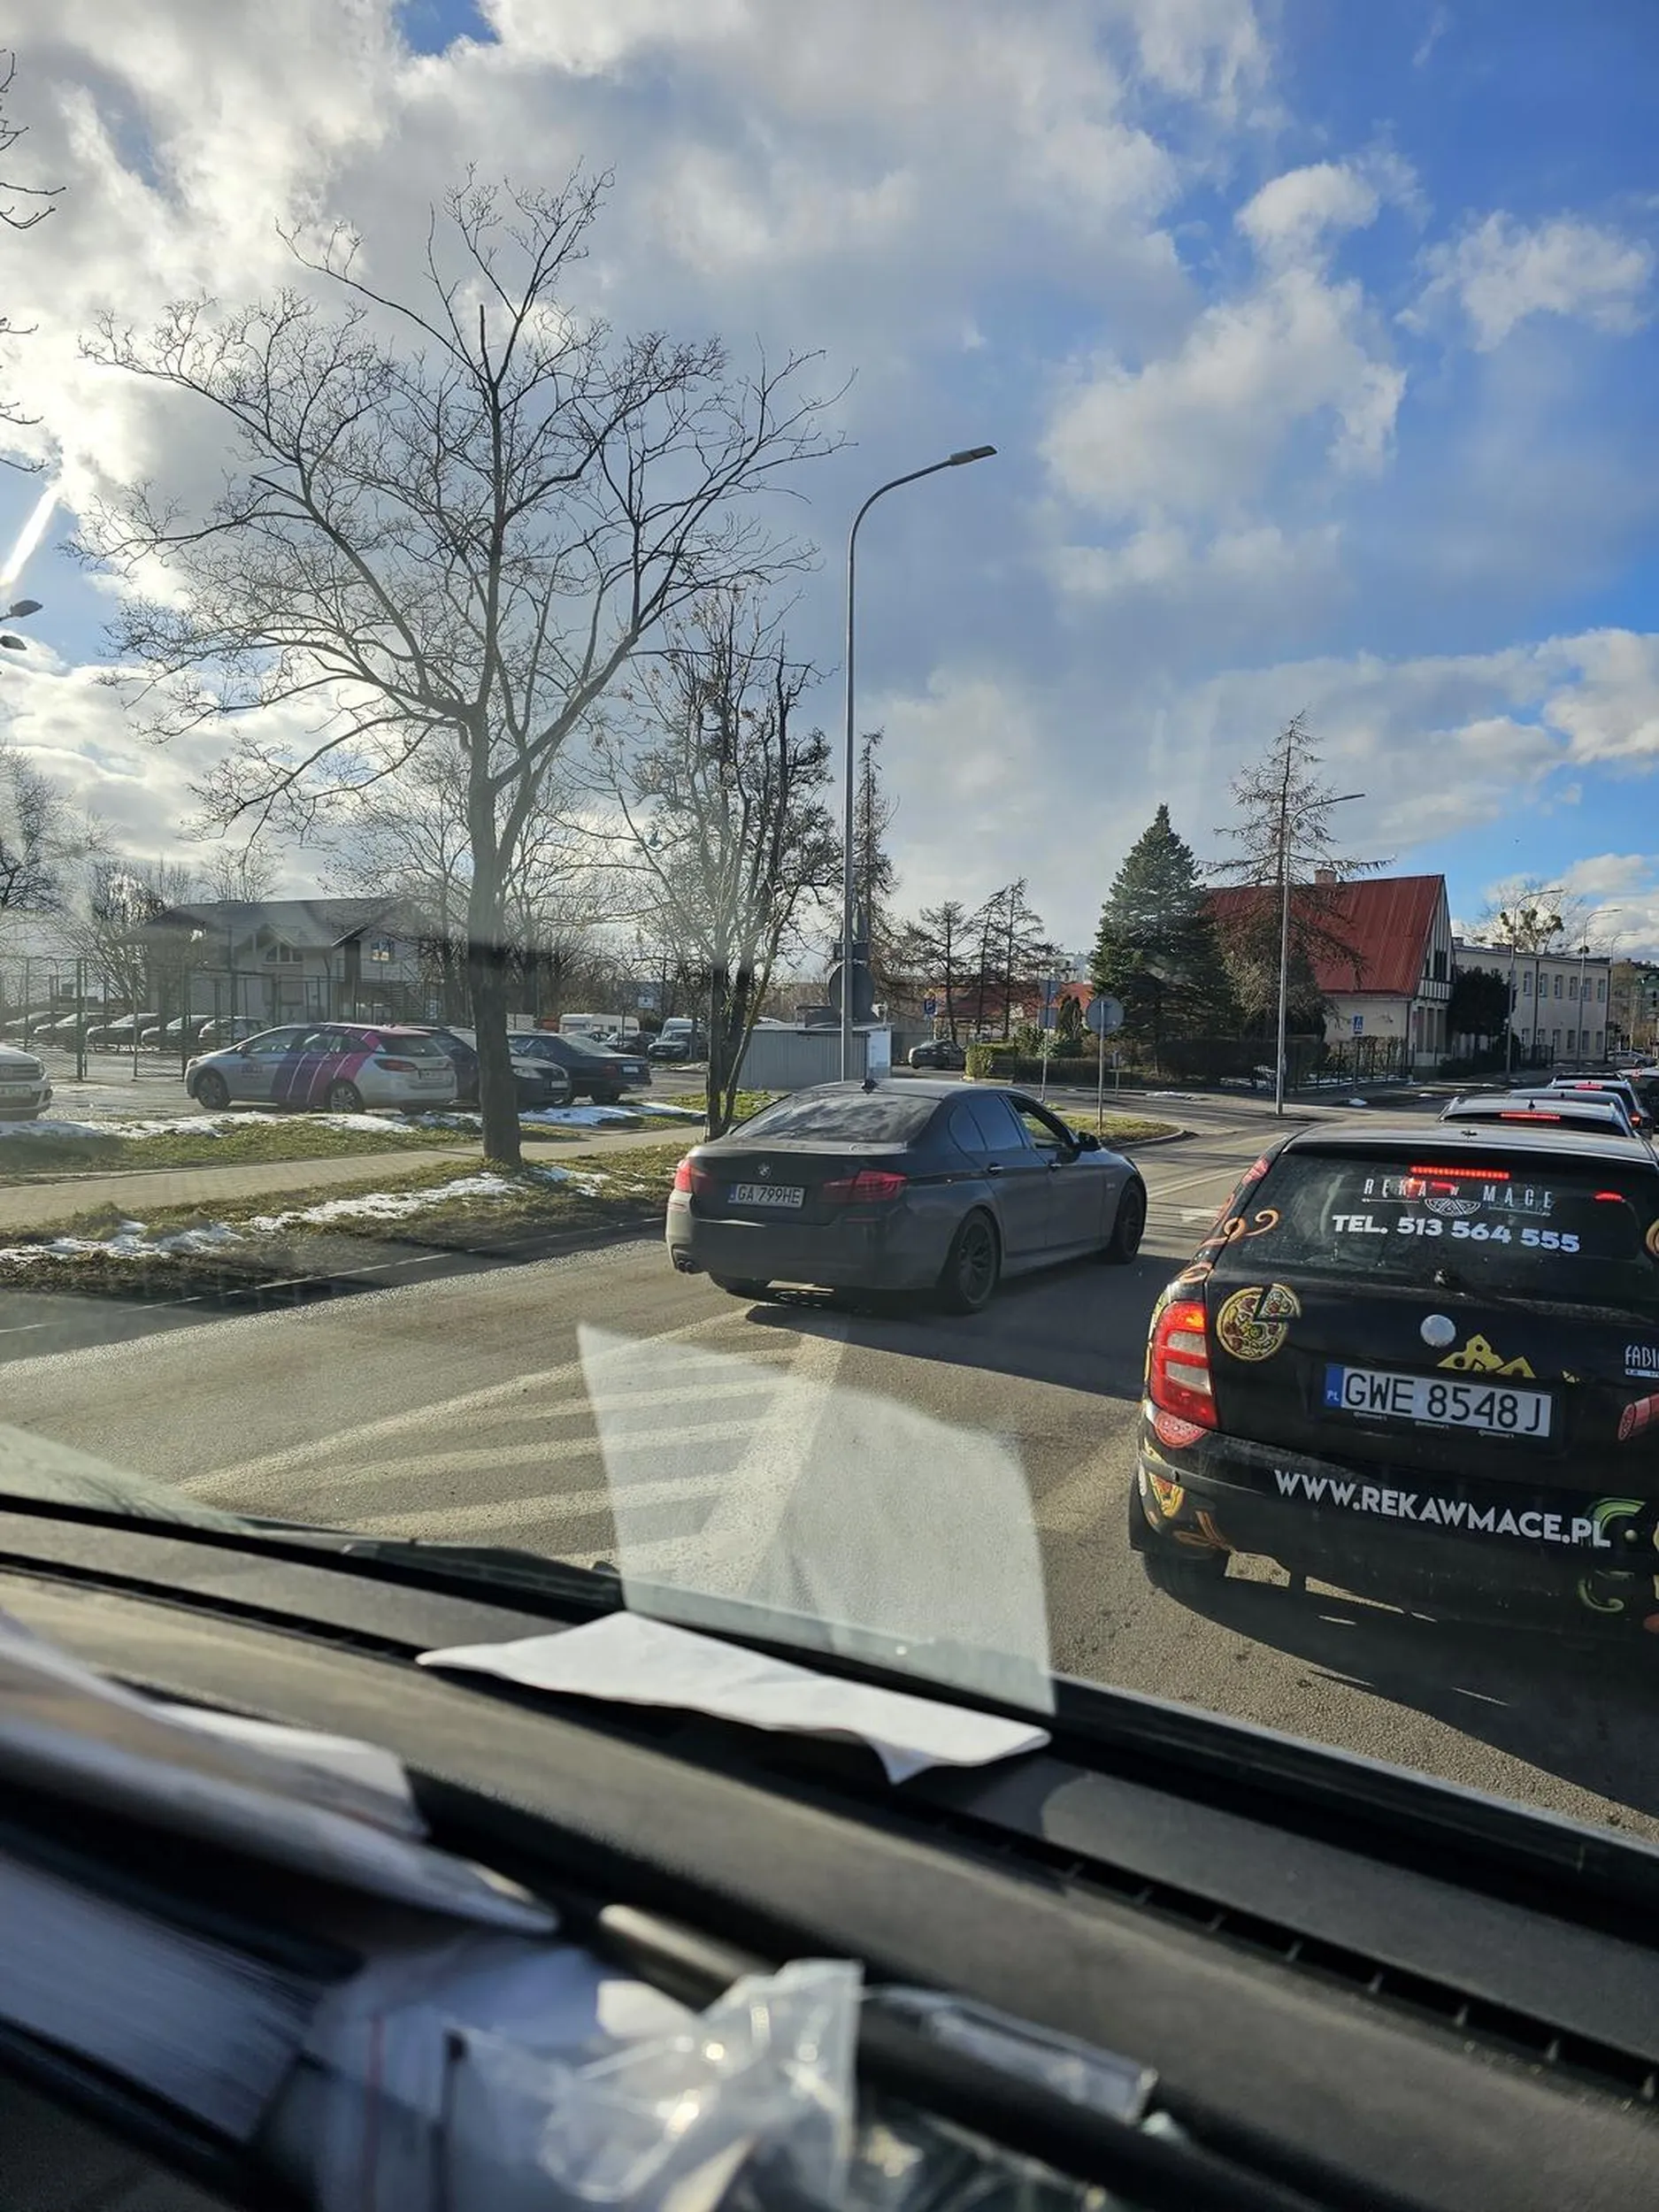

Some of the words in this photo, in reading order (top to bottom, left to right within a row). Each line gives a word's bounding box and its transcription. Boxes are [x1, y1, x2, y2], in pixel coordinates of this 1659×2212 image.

[738, 1186, 755, 1202] GA
[758, 1187, 801, 1204] 799HE
[1332, 1214, 1388, 1234] TEL.
[1396, 1217, 1443, 1236] 513
[1451, 1220, 1512, 1243] 564
[1520, 1228, 1580, 1253] 555
[1624, 1345, 1659, 1370] FABI
[1327, 1390, 1340, 1402] PL
[1345, 1373, 1414, 1414] GWE
[1427, 1384, 1541, 1432] 8548J
[1274, 1469, 1611, 1548] WWW.REKAWMACE.PL
